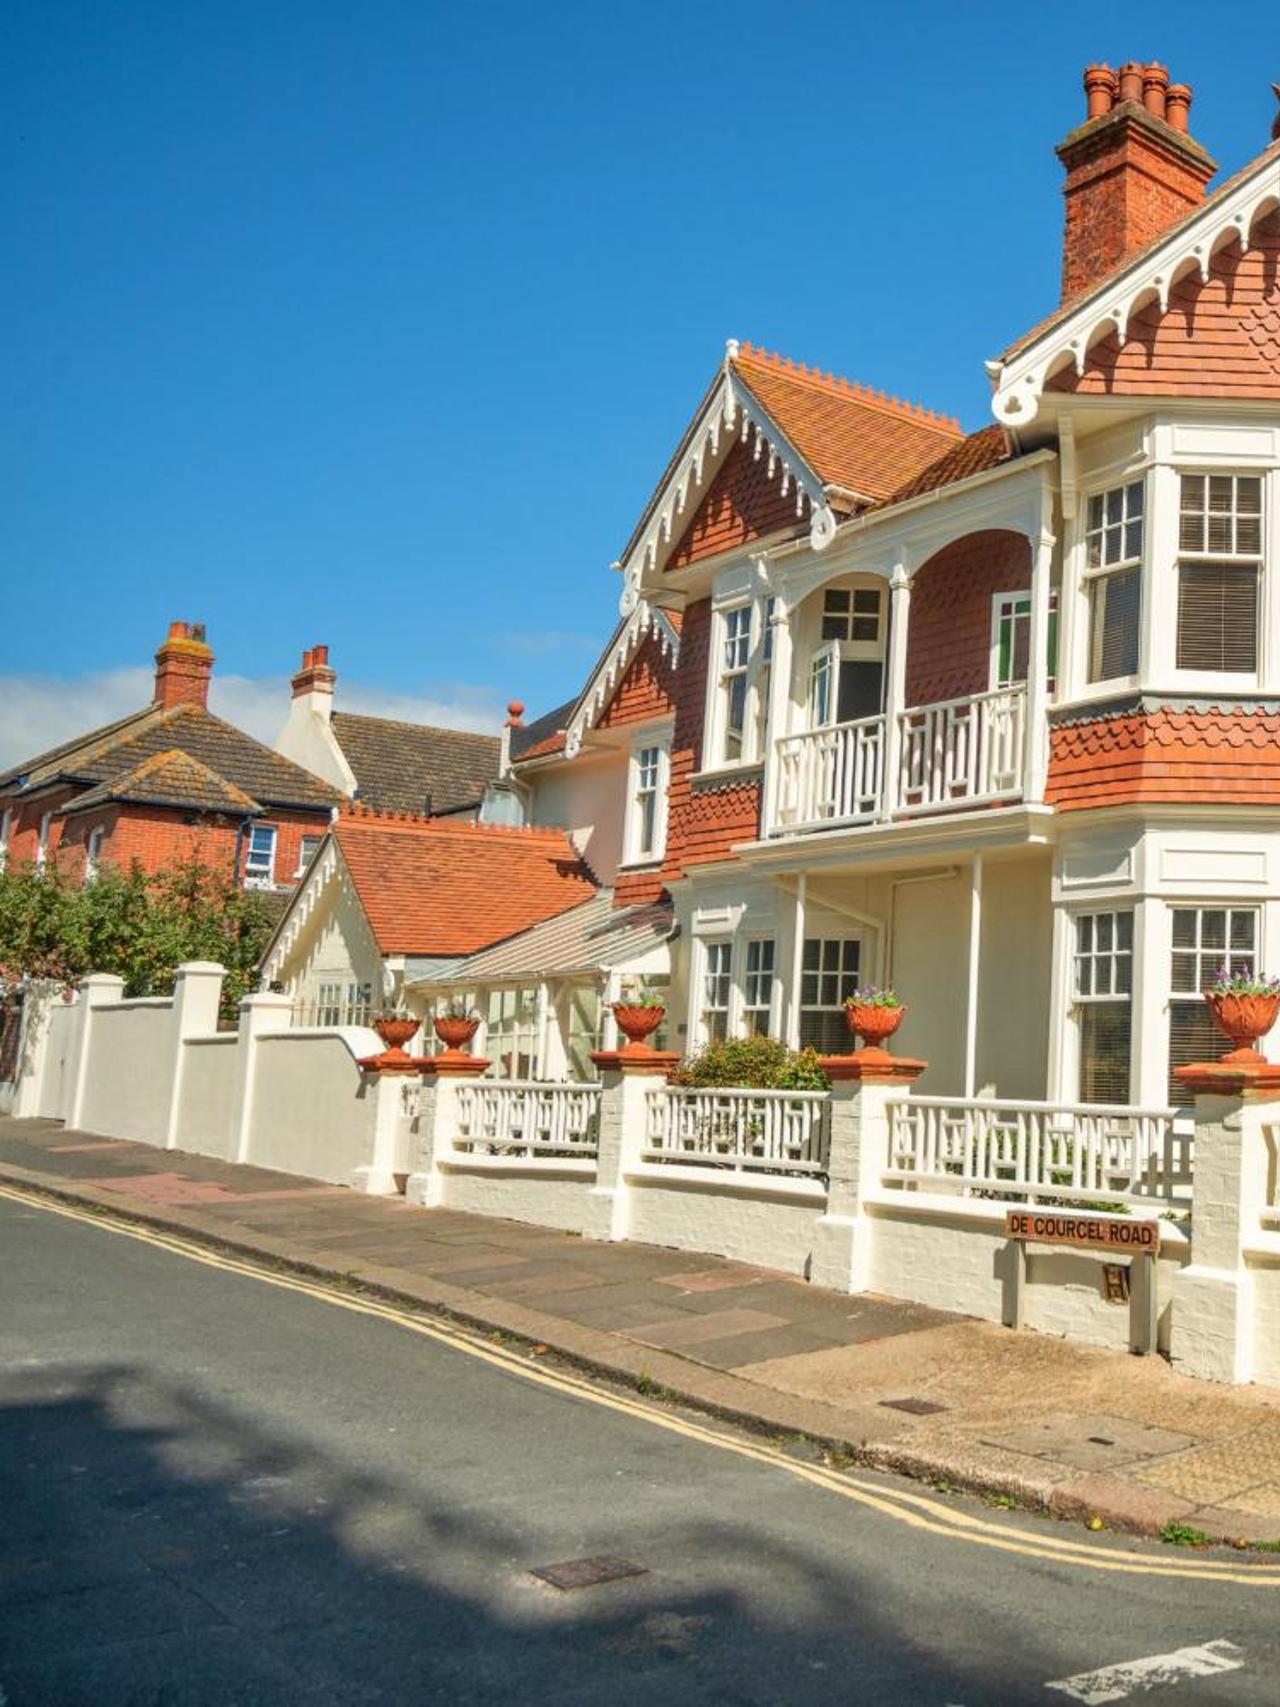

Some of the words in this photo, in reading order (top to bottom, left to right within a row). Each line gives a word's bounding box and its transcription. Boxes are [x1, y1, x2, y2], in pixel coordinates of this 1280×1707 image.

[1011, 1215, 1028, 1233] DE
[1034, 1217, 1104, 1241] COURCEL
[1110, 1224, 1152, 1245] ROAD
